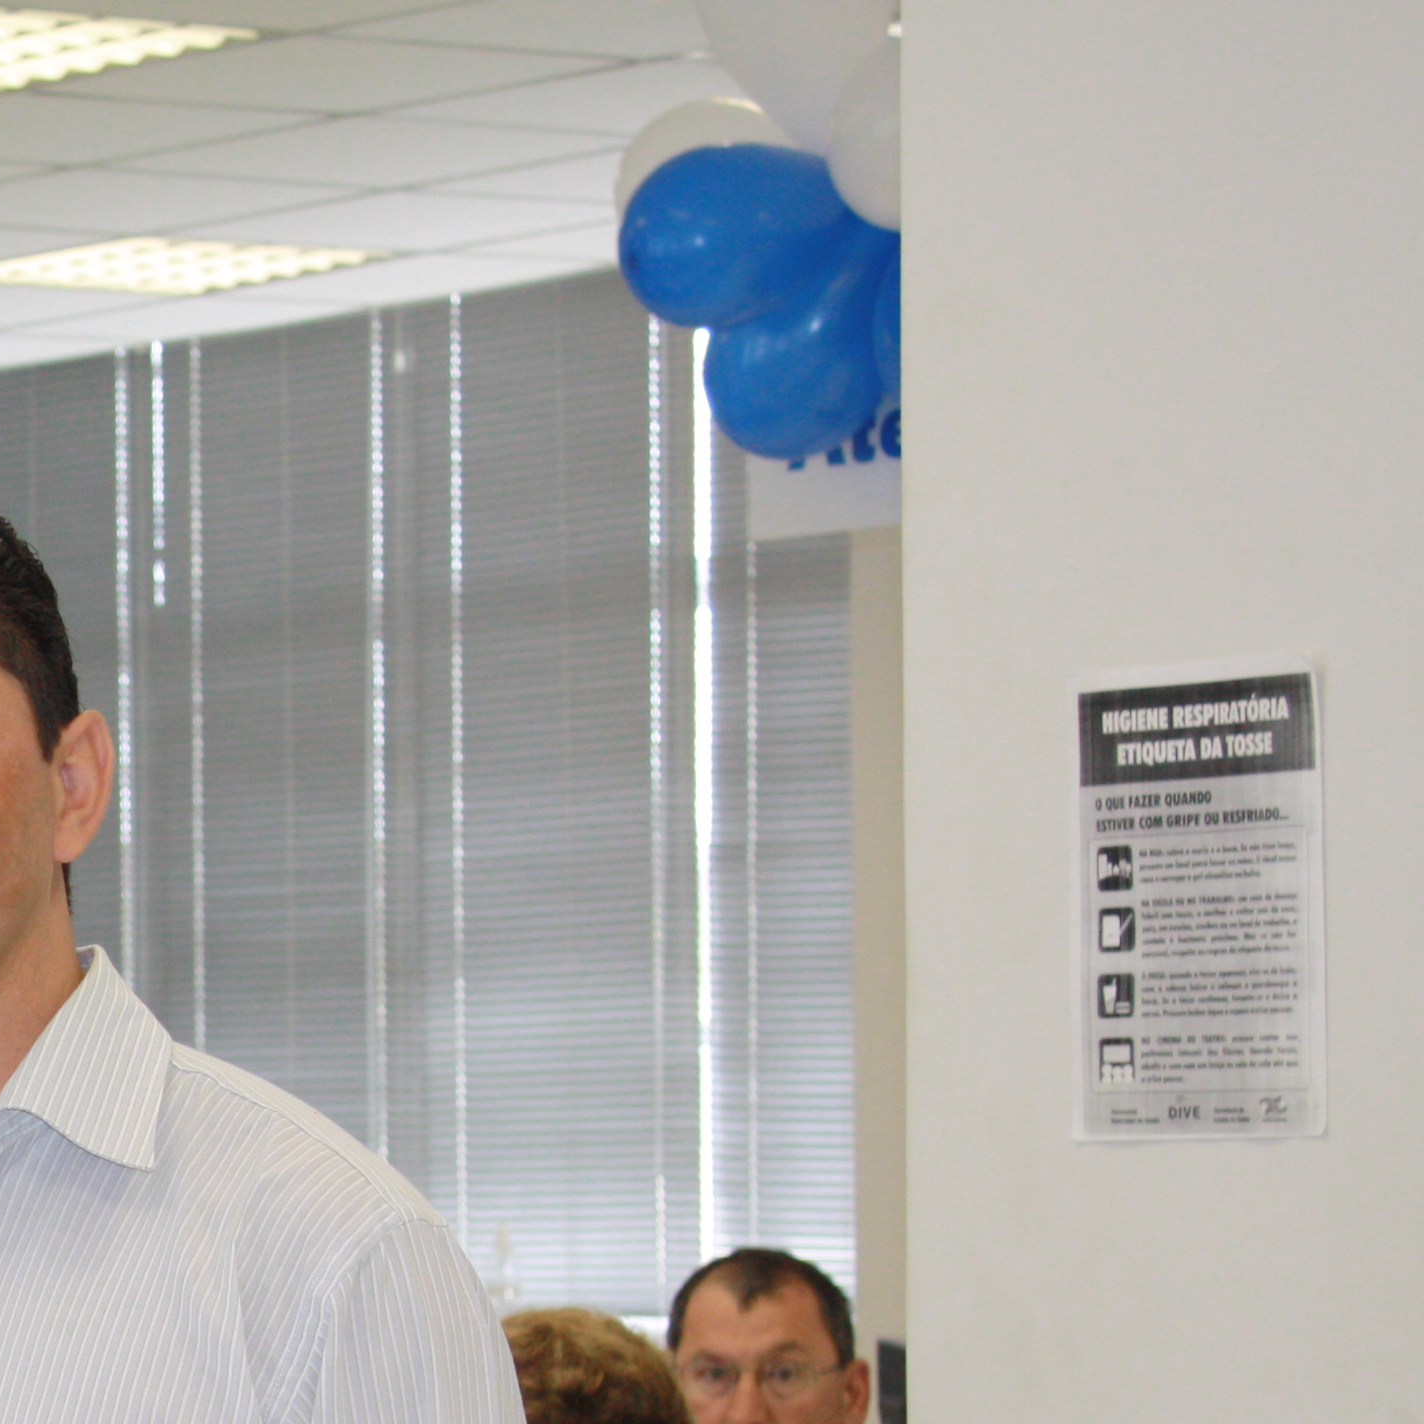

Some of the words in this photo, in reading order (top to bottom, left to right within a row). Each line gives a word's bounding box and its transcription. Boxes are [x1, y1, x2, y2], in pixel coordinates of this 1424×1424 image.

[1102, 706, 1169, 734] HIGIENE
[1173, 692, 1290, 729] RESPIRATÓRIA
[1116, 738, 1196, 767] ETIQUETA
[1200, 736, 1223, 759] DA
[1226, 732, 1273, 757] TOSSE
[1095, 799, 1102, 811] O
[1105, 797, 1125, 811] QUE
[1128, 794, 1161, 808] FAZER
[1164, 791, 1212, 807] QUANDO
[1096, 817, 1135, 833] ESTIVER
[1139, 815, 1163, 829] COM
[1166, 813, 1201, 828] GRIPE
[1204, 812, 1219, 826] OU
[1168, 1105, 1201, 1120] DIVE
